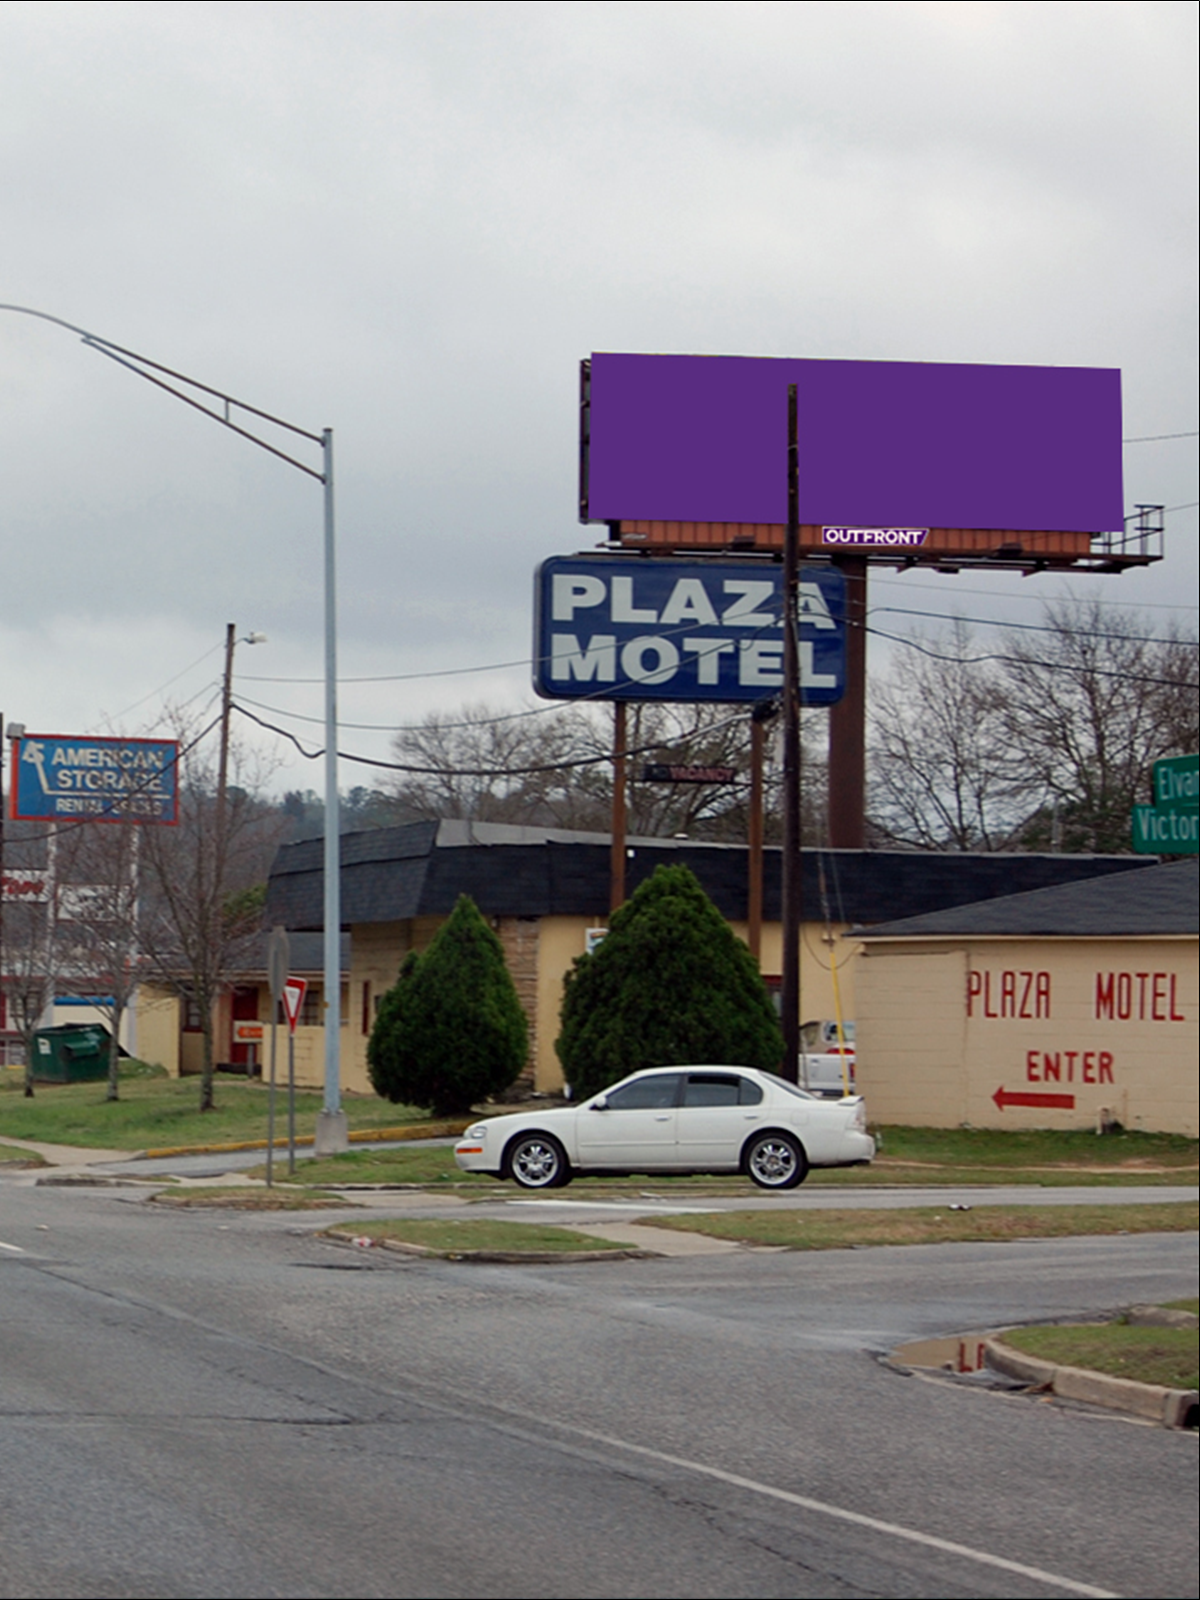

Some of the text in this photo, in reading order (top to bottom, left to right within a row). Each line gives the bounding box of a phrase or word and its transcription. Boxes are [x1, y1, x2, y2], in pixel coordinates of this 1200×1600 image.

[825, 529, 923, 544] OUTFRONT
[552, 573, 837, 630] PLAZA
[551, 633, 837, 688] MOTEL
[52, 747, 164, 770] AMERICAN
[57, 769, 163, 792] STORAGE
[669, 767, 735, 782] VACANCY
[966, 971, 1185, 1021] PLAZA MOTEL
[1027, 1051, 1114, 1084] ENTER
